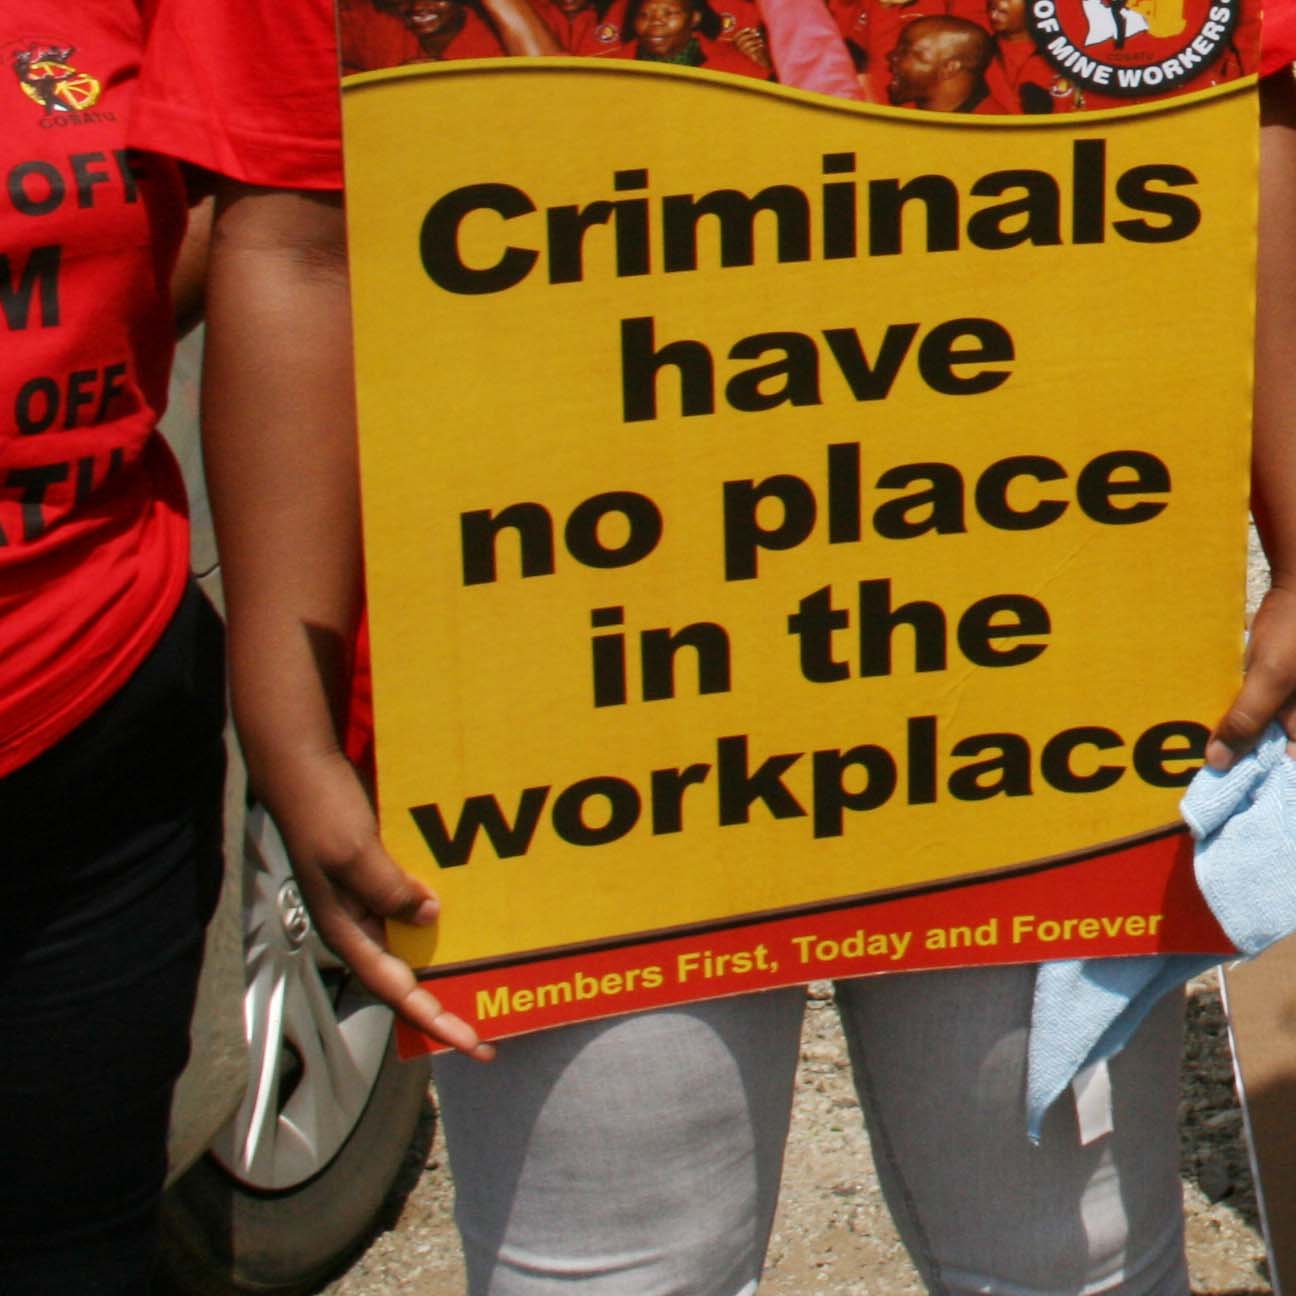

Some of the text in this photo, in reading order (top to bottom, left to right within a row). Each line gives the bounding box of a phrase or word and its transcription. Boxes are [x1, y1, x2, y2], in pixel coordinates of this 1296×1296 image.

[1033, 0, 1231, 88] OF MINE WORKERS
[418, 138, 1201, 296] Criminals
[15, 363, 128, 435] OFF
[620, 316, 1016, 423] have
[460, 441, 1172, 586] no place
[590, 577, 1052, 708] in the
[408, 715, 1212, 869] workplace
[475, 909, 1164, 1020] Members First, Today and Forever
